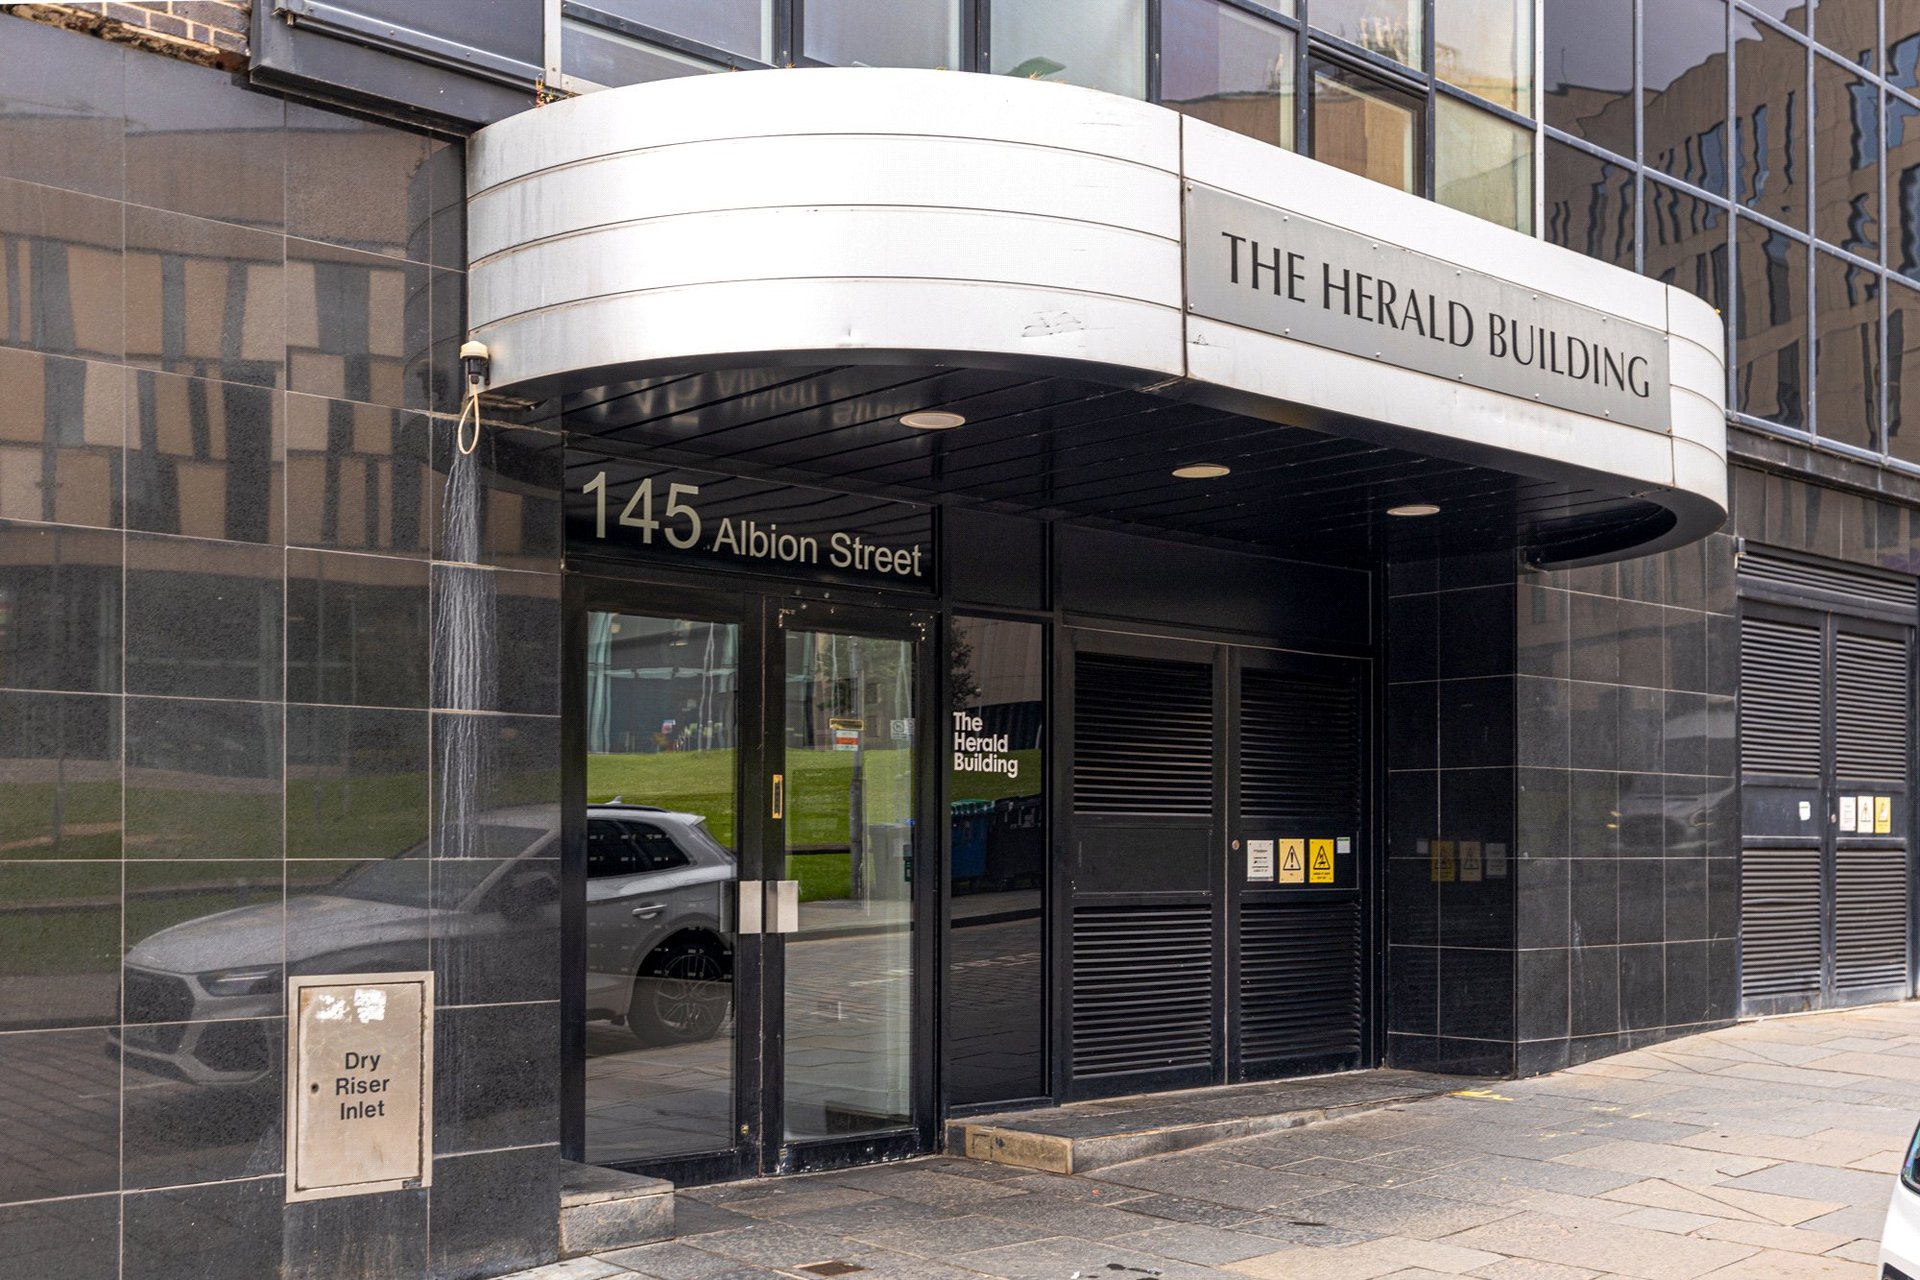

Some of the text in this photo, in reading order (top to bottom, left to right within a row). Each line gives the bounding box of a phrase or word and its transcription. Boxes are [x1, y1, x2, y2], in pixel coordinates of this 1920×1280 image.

[1221, 231, 1650, 398] THE HERALD BUILDING
[583, 471, 922, 577] 145 Albion Street
[953, 711, 983, 731] The
[954, 732, 1008, 752] Herald
[954, 752, 1018, 778] Building
[345, 1052, 381, 1071] Dry
[335, 1077, 390, 1096] Riser
[340, 1100, 385, 1120] Inlet
